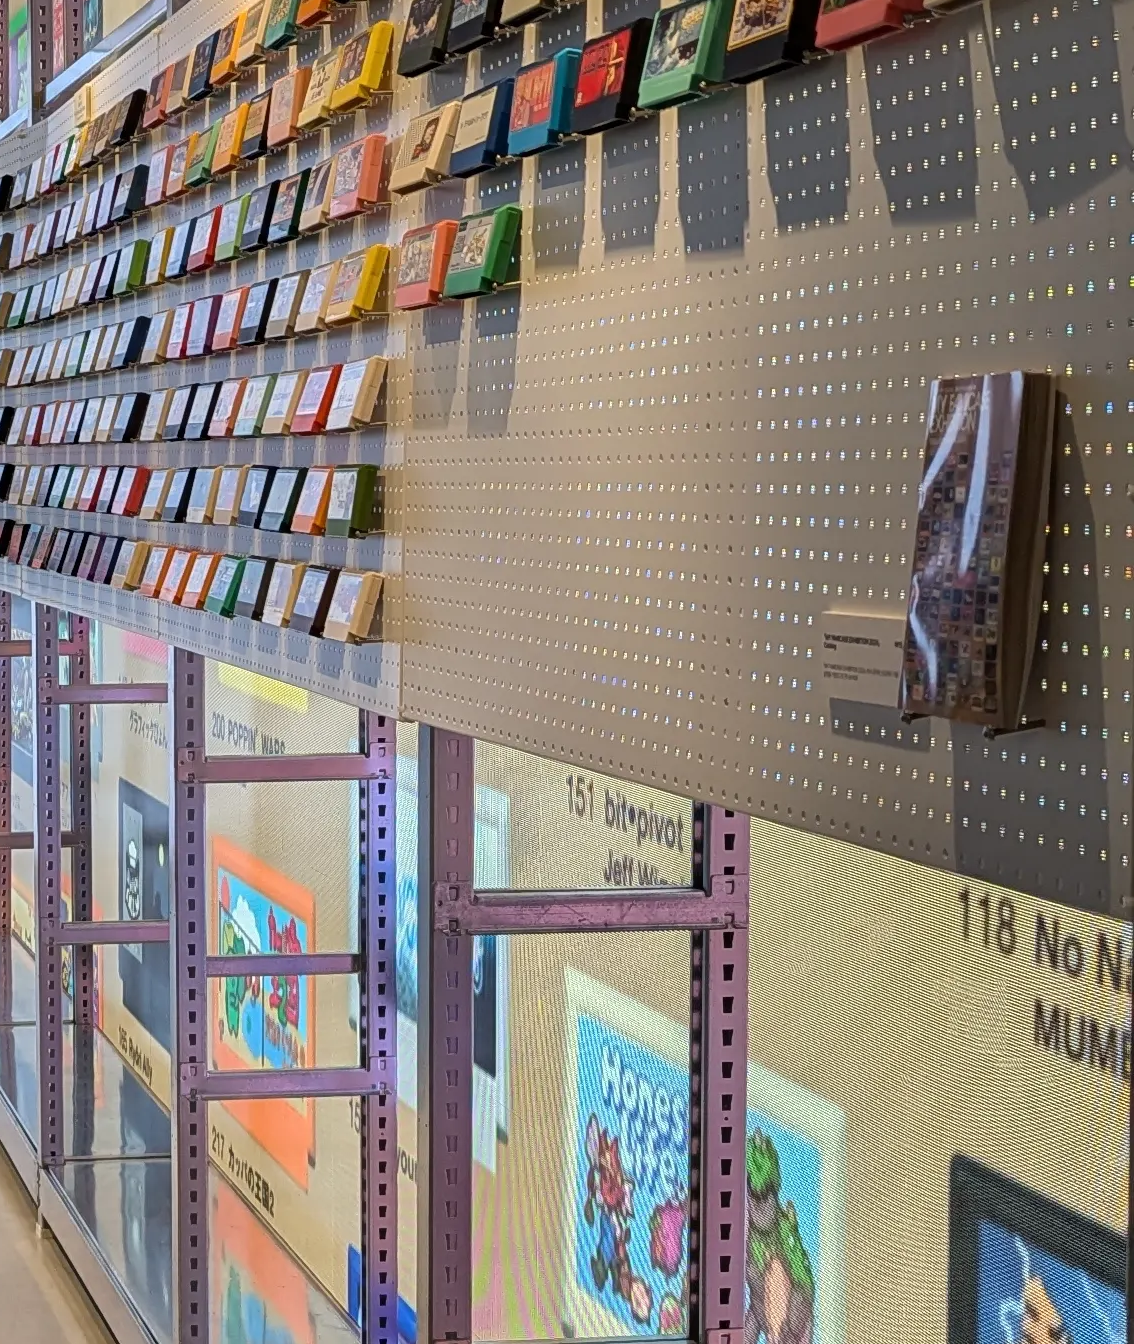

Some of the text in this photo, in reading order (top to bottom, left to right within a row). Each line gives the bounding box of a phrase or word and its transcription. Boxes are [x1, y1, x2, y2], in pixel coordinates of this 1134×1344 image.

[212, 712, 225, 740] 200
[566, 775, 594, 820] 151
[603, 849, 634, 886] Jeff
[958, 883, 1017, 957] 118
[1034, 911, 1084, 979] No
[1032, 997, 1131, 1079] MUM
[211, 1126, 226, 1158] 217
